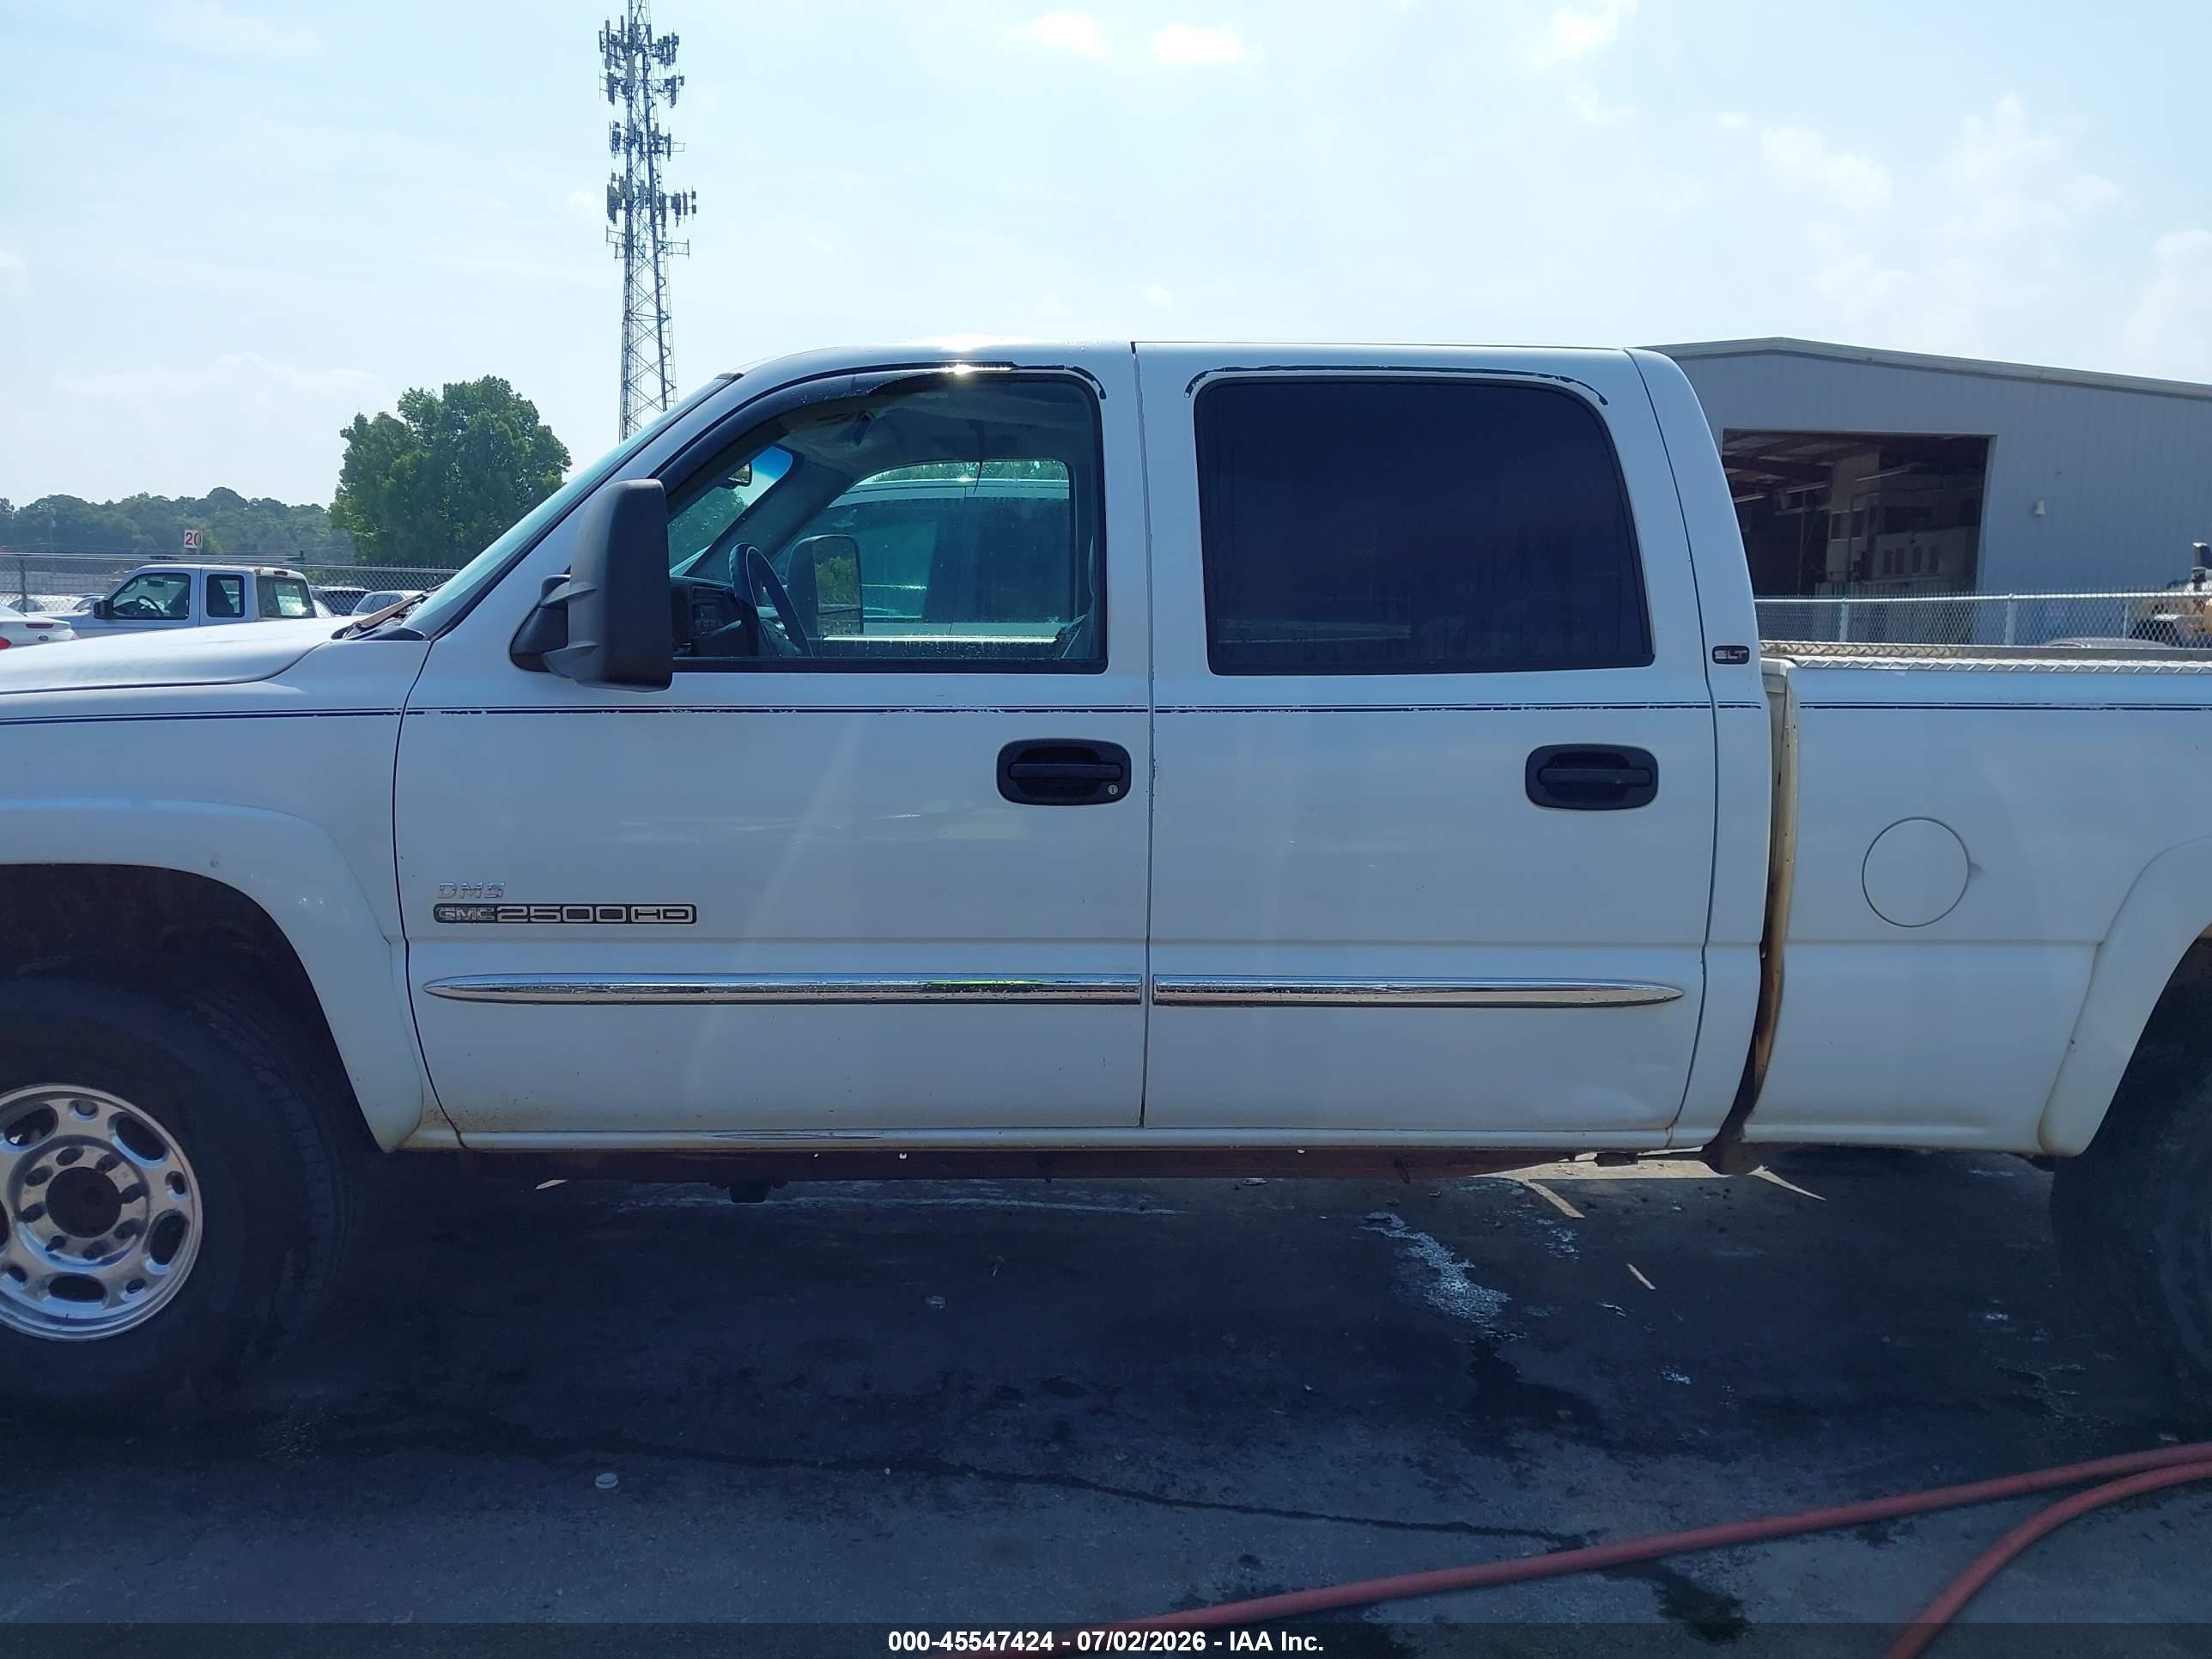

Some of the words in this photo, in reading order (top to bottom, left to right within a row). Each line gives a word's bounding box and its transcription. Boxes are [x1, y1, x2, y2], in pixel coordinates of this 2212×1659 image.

[185, 532, 202, 546] 20
[1715, 650, 1747, 659] SLT
[437, 906, 495, 921] GMC
